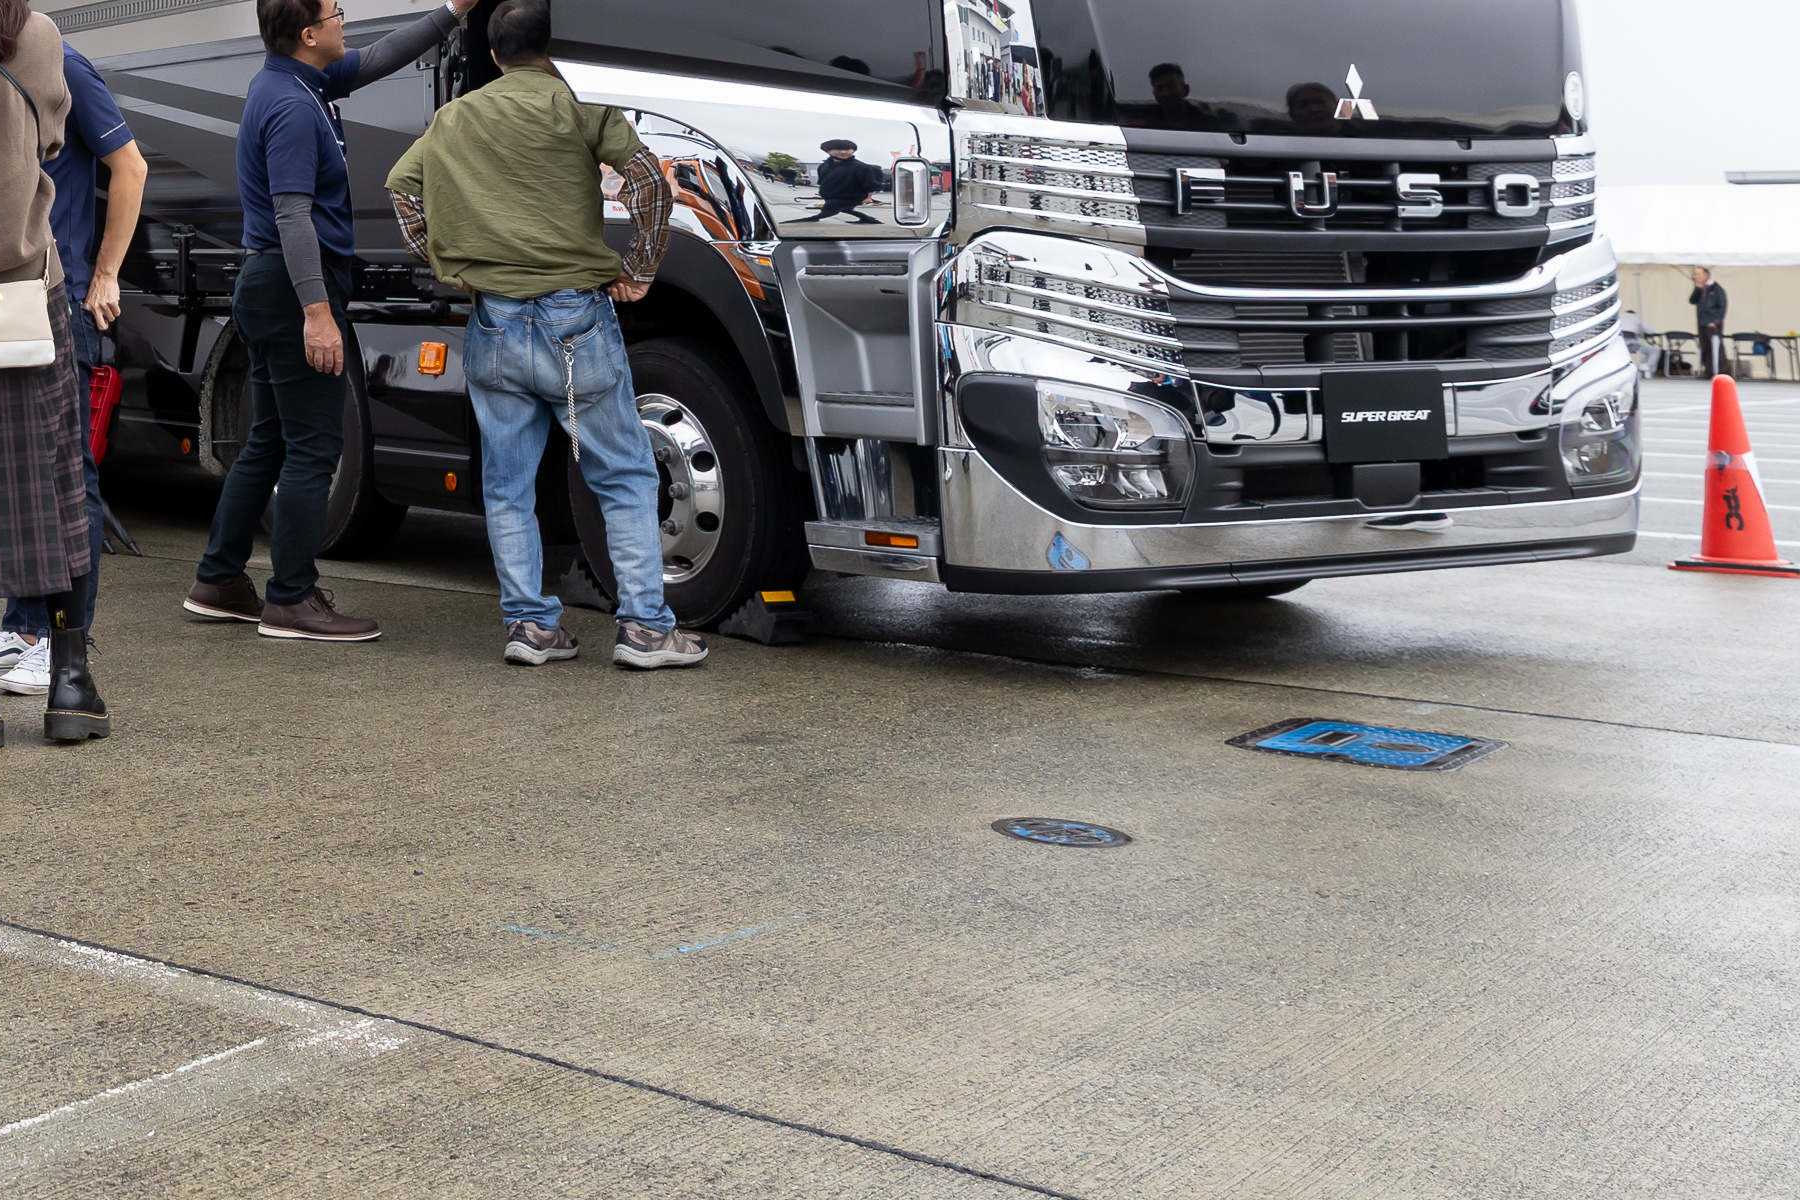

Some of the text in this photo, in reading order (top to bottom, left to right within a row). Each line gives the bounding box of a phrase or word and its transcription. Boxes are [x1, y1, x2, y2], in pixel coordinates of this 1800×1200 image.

[1175, 167, 1542, 218] FUSO
[1341, 409, 1432, 423] SUPER GREAT
